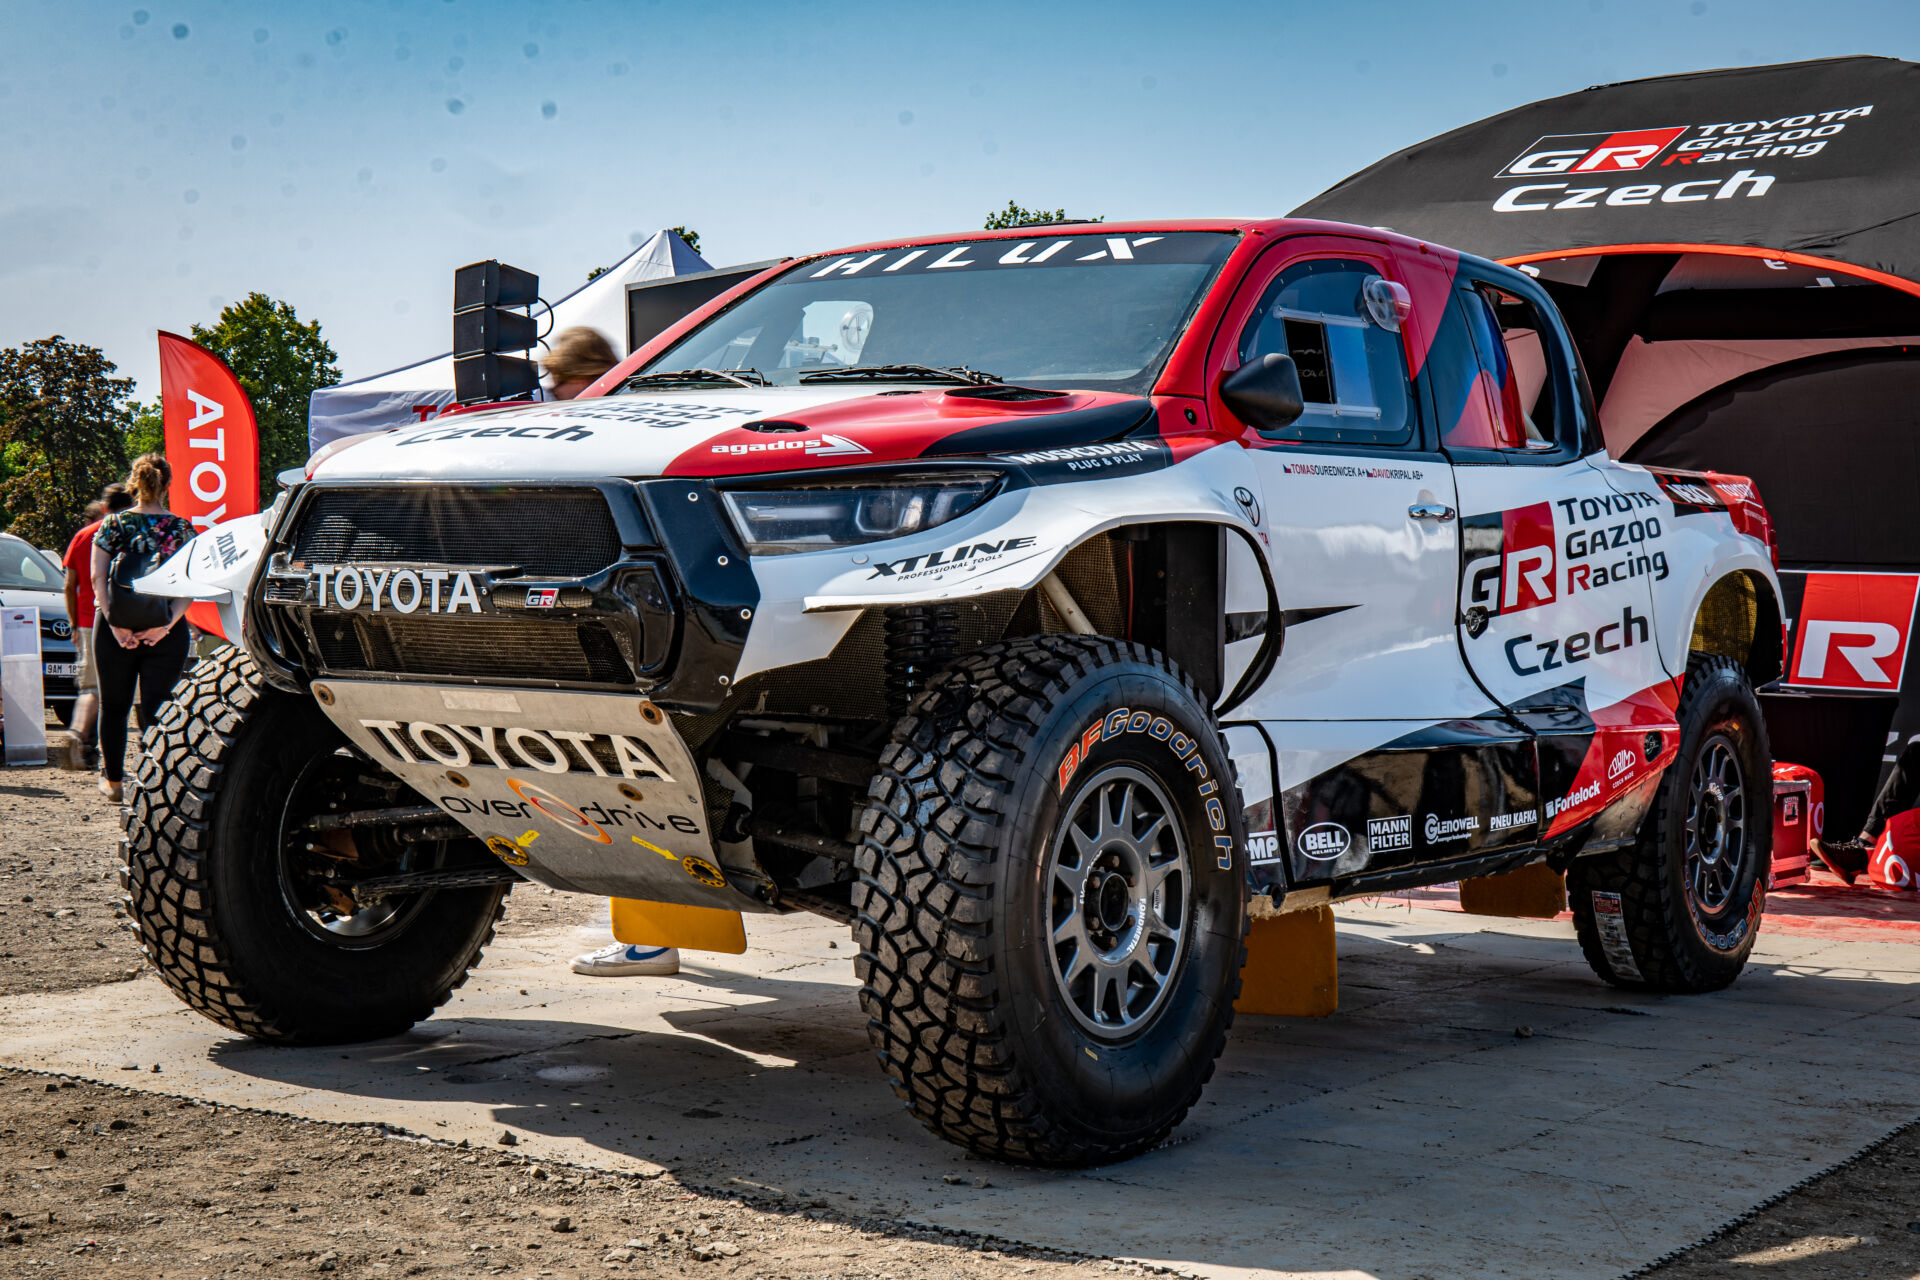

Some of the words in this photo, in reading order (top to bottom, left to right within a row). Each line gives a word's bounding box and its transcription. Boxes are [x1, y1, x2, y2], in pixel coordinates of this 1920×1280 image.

[1698, 105, 1873, 136] TOYOTA
[1677, 123, 1845, 152] GAZOO
[1509, 144, 1660, 174] GR
[1660, 141, 1828, 166] Racing
[1493, 169, 1776, 212] Czech
[809, 237, 1165, 278] HILUX
[396, 425, 594, 446] Czech
[711, 439, 821, 455] agados
[1008, 441, 1160, 465] MUSICDATA
[1067, 459, 1100, 471] PLUG
[1102, 457, 1112, 467] &
[1114, 453, 1143, 465] PLAY
[1558, 491, 1660, 525] TOYOTA
[1565, 516, 1662, 560] GAZOO
[866, 536, 1037, 580] XTLINE
[897, 561, 968, 581] PROFESSIONAL
[973, 553, 1003, 564] TOOLS
[1567, 550, 1669, 595] Racing
[312, 563, 483, 614] TOYOTA
[1460, 545, 1554, 616] GR
[527, 593, 554, 607] GR
[1504, 605, 1649, 677] Czech
[1797, 619, 1900, 683] R
[358, 718, 677, 784] TOYOTA
[1058, 707, 1233, 871] BFGoodrich
[1554, 780, 1600, 815] Fortelock
[439, 794, 531, 819] over
[1490, 813, 1512, 829] PNEU
[1513, 809, 1538, 825] KAFKA
[1305, 830, 1344, 850] BELL
[1370, 818, 1409, 836] MANN
[1371, 832, 1410, 849] FILTER
[1244, 836, 1279, 860] MP
